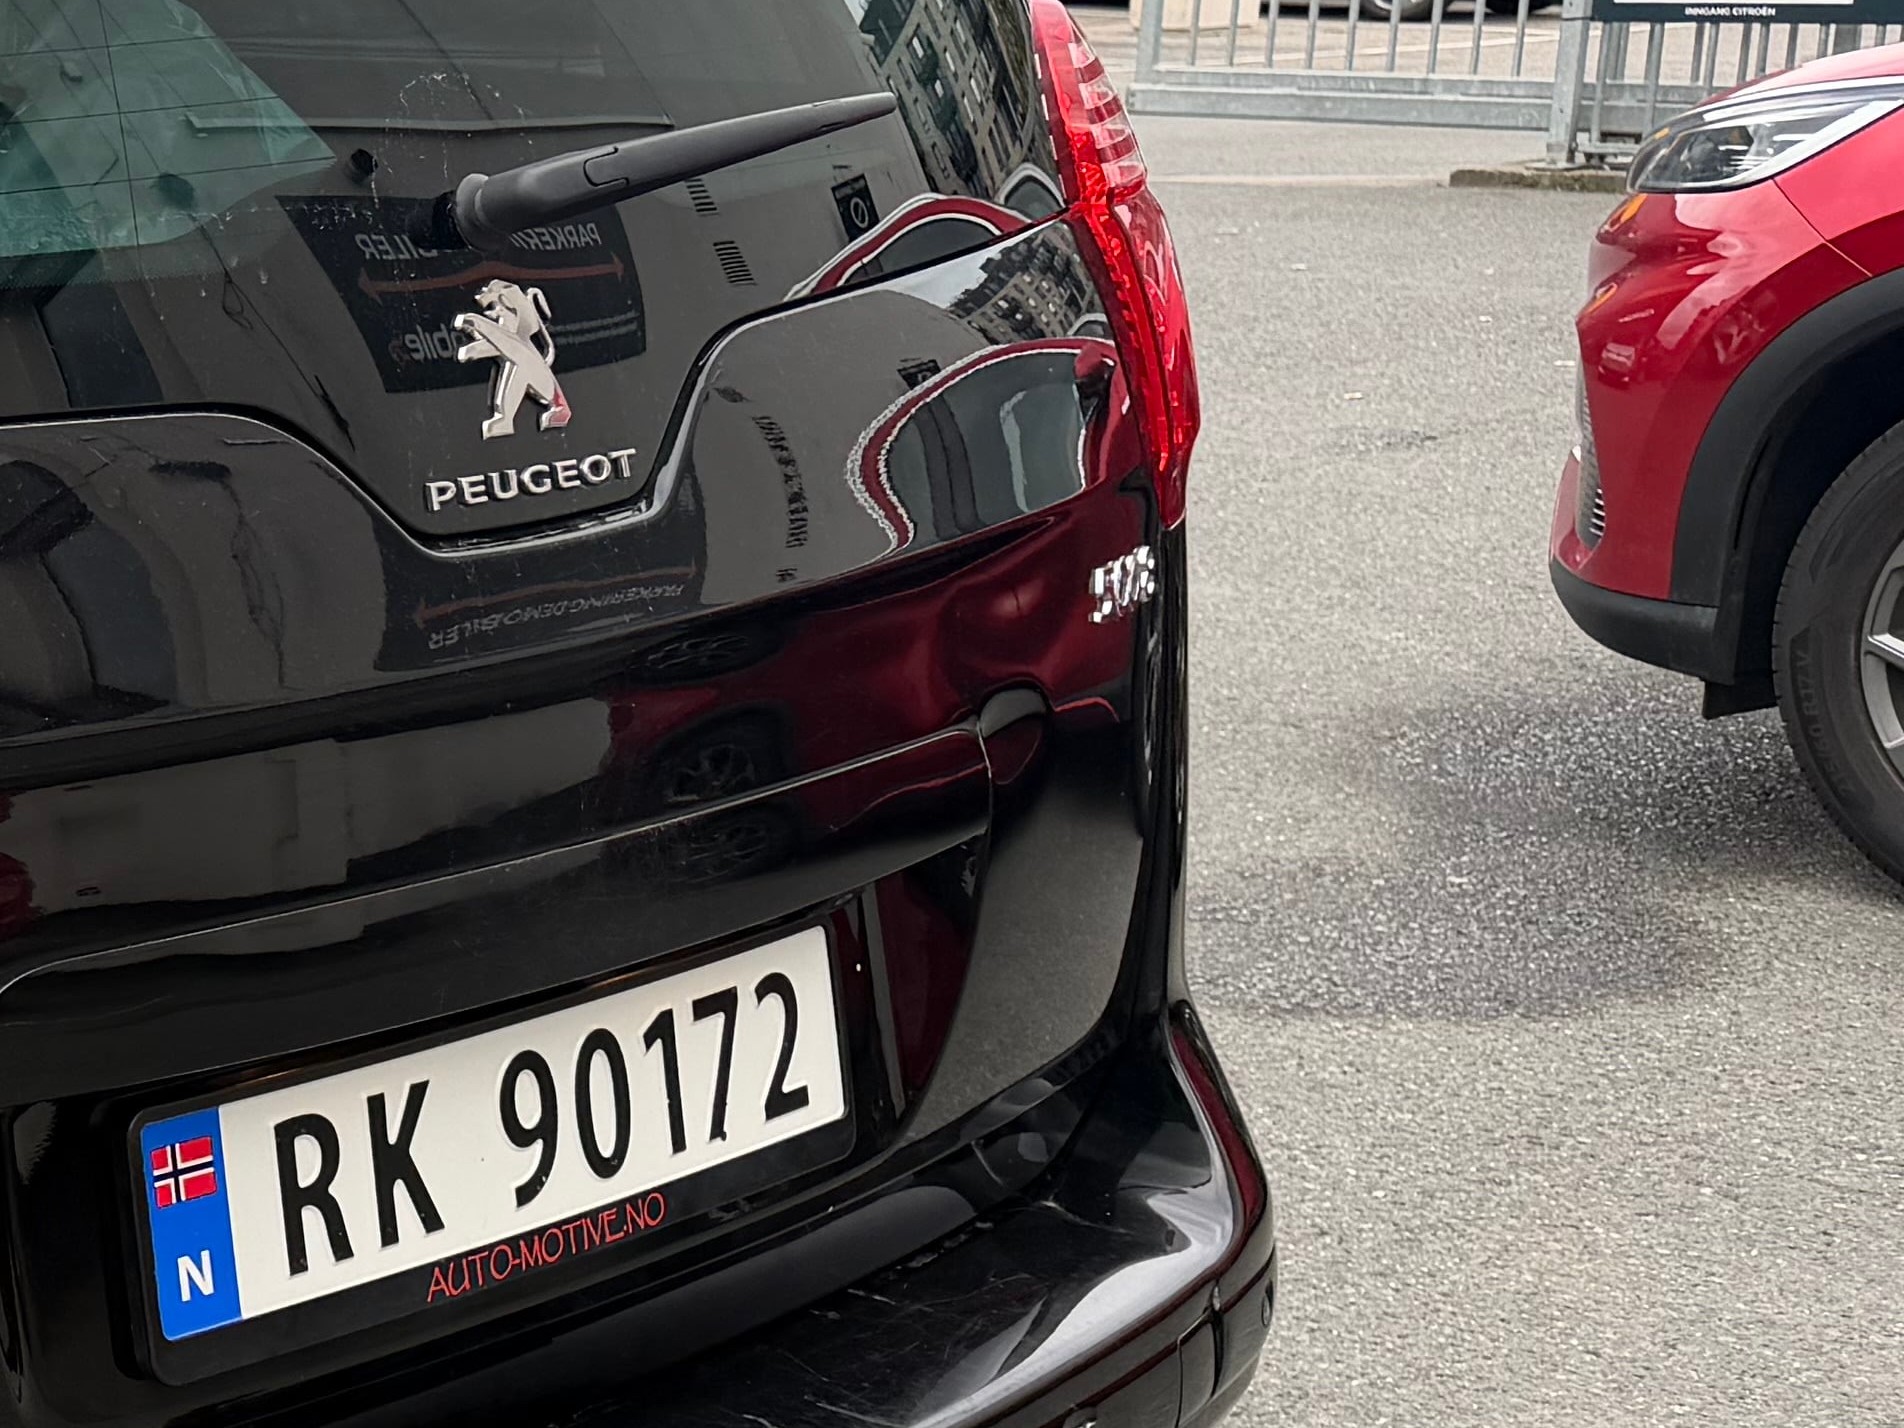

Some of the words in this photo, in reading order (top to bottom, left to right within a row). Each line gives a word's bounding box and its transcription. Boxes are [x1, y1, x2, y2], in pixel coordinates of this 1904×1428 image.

[425, 447, 637, 512] PEUGEOT
[274, 1079, 447, 1278] RK
[499, 971, 811, 1208] 90172
[177, 1249, 215, 1303] N
[426, 1191, 667, 1303] AUTO-MOTIVE.NO
